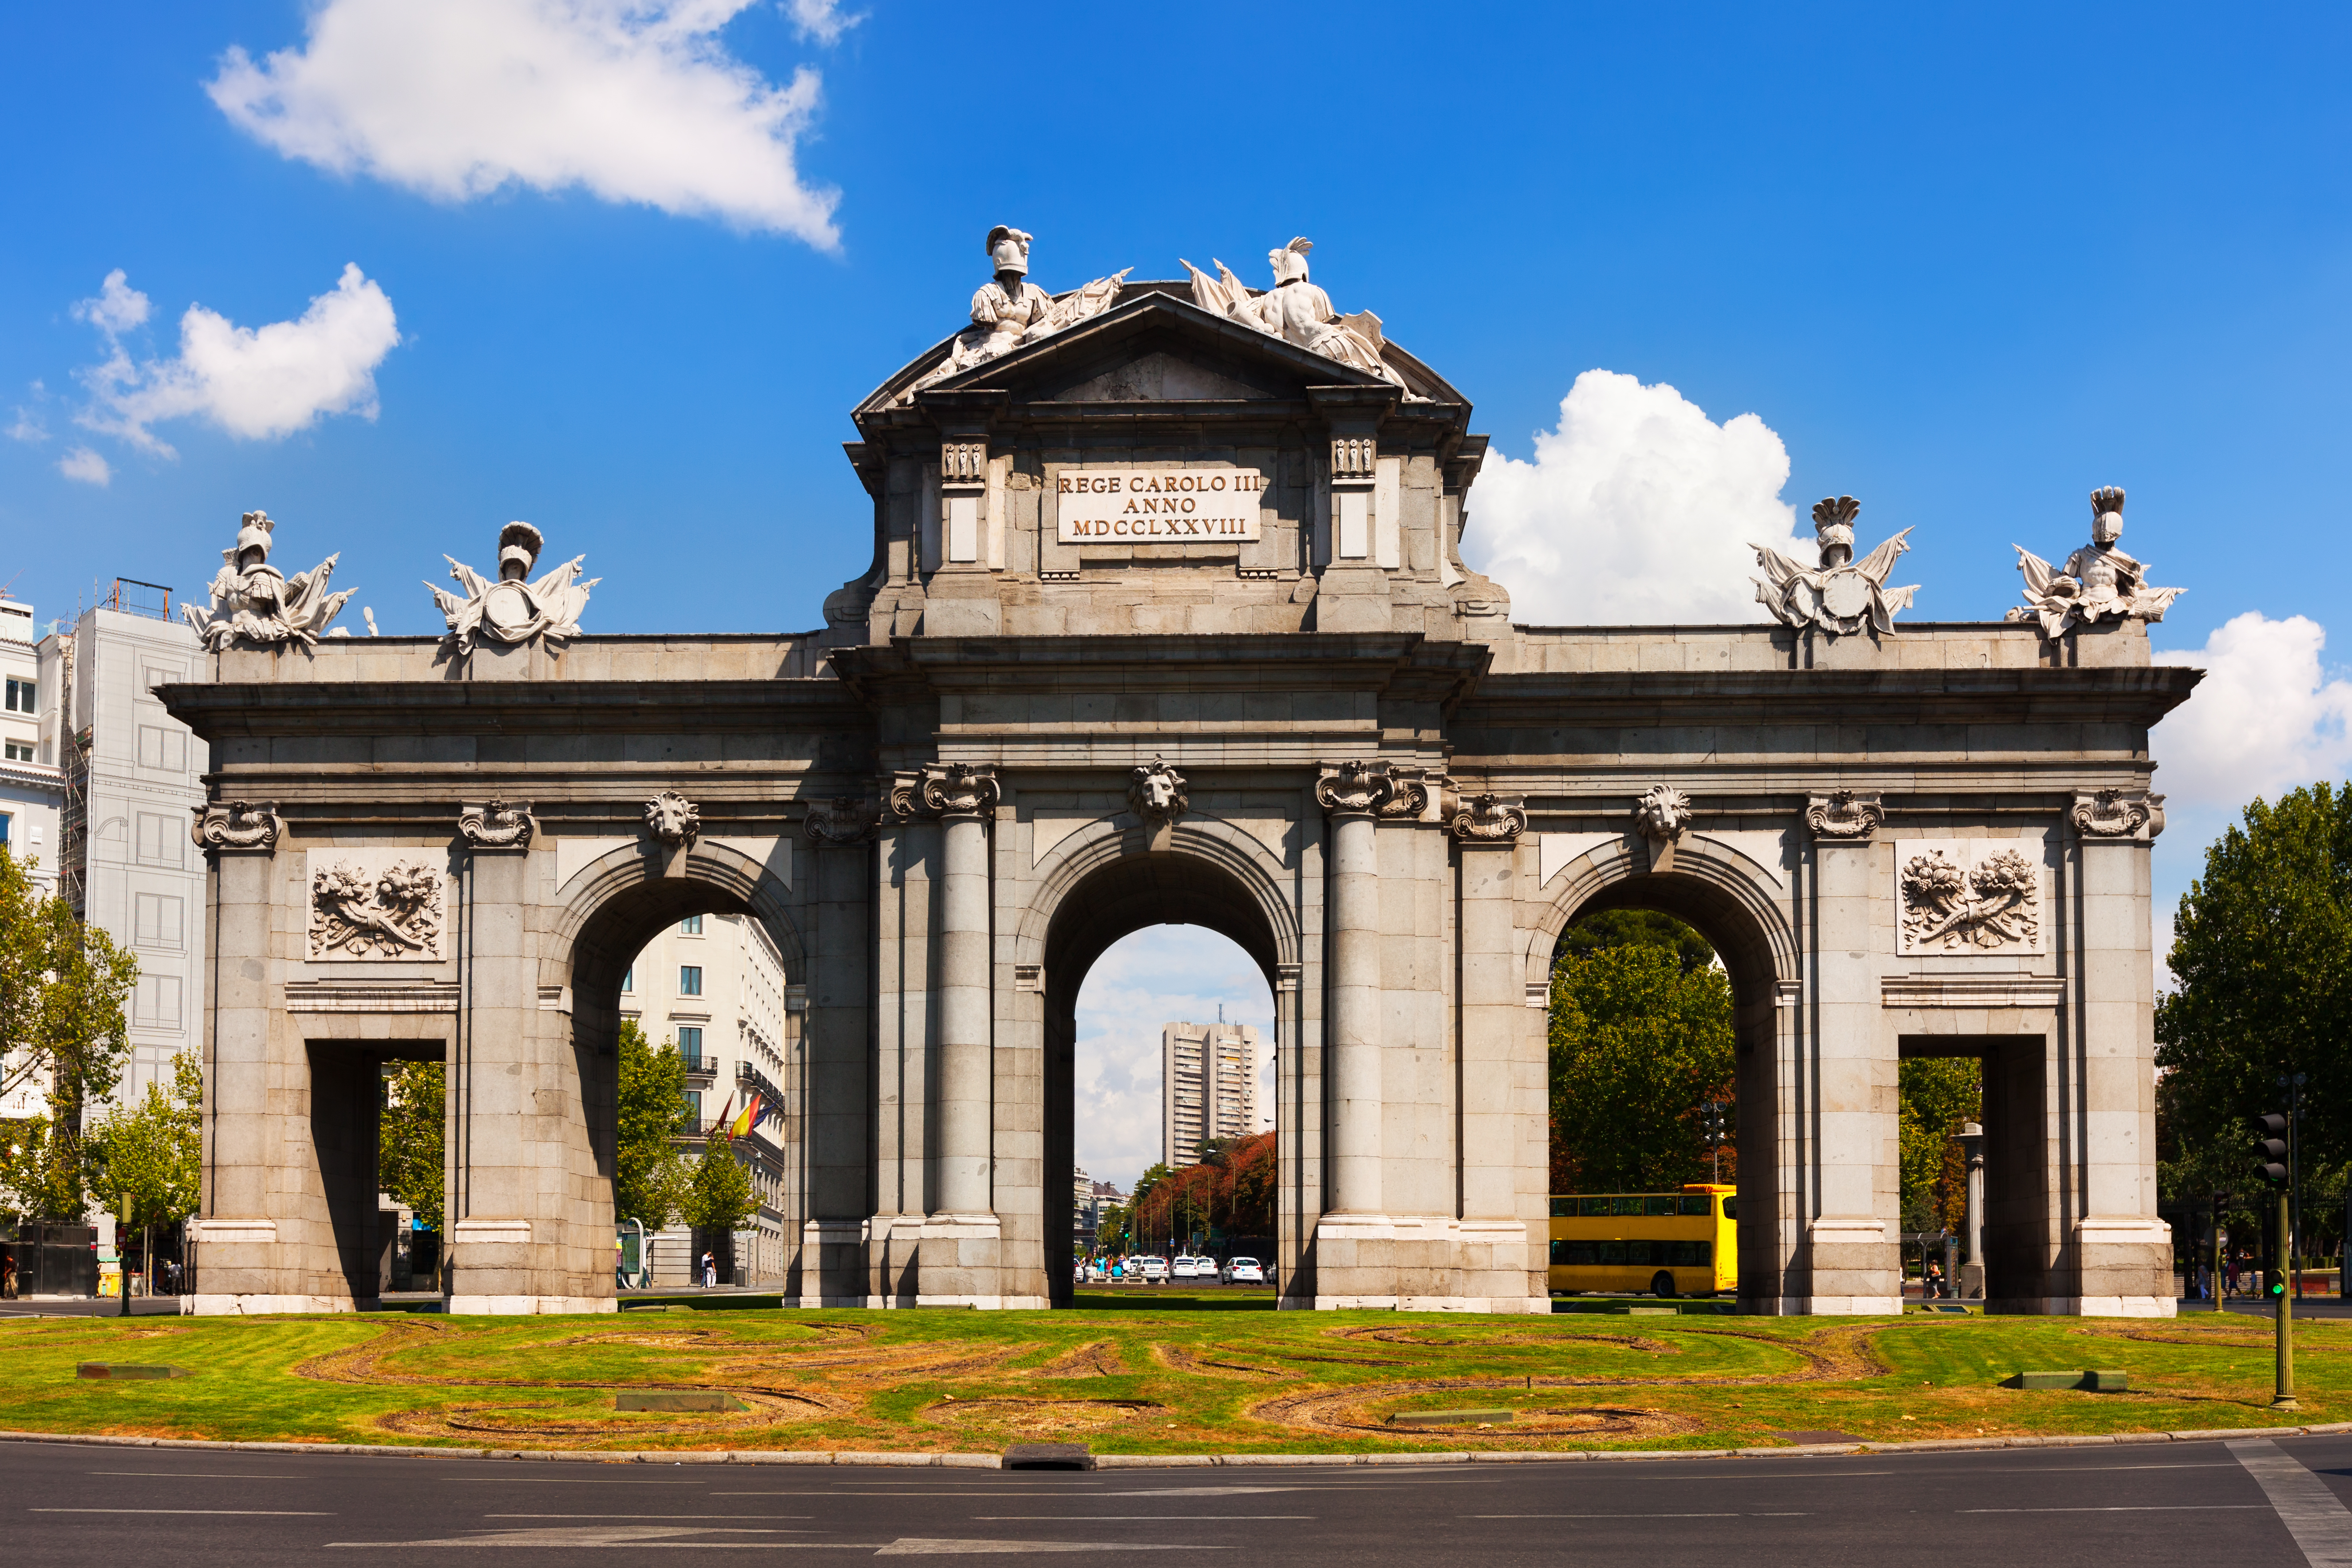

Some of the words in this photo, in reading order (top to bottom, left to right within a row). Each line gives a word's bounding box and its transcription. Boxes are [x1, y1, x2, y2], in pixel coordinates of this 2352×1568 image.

[1059, 477, 1121, 493] REGE
[1130, 476, 1226, 492] CAROLO
[1234, 475, 1260, 491] III
[1123, 498, 1196, 514] ANNO
[1073, 518, 1246, 536] MDCCLXXVIII
